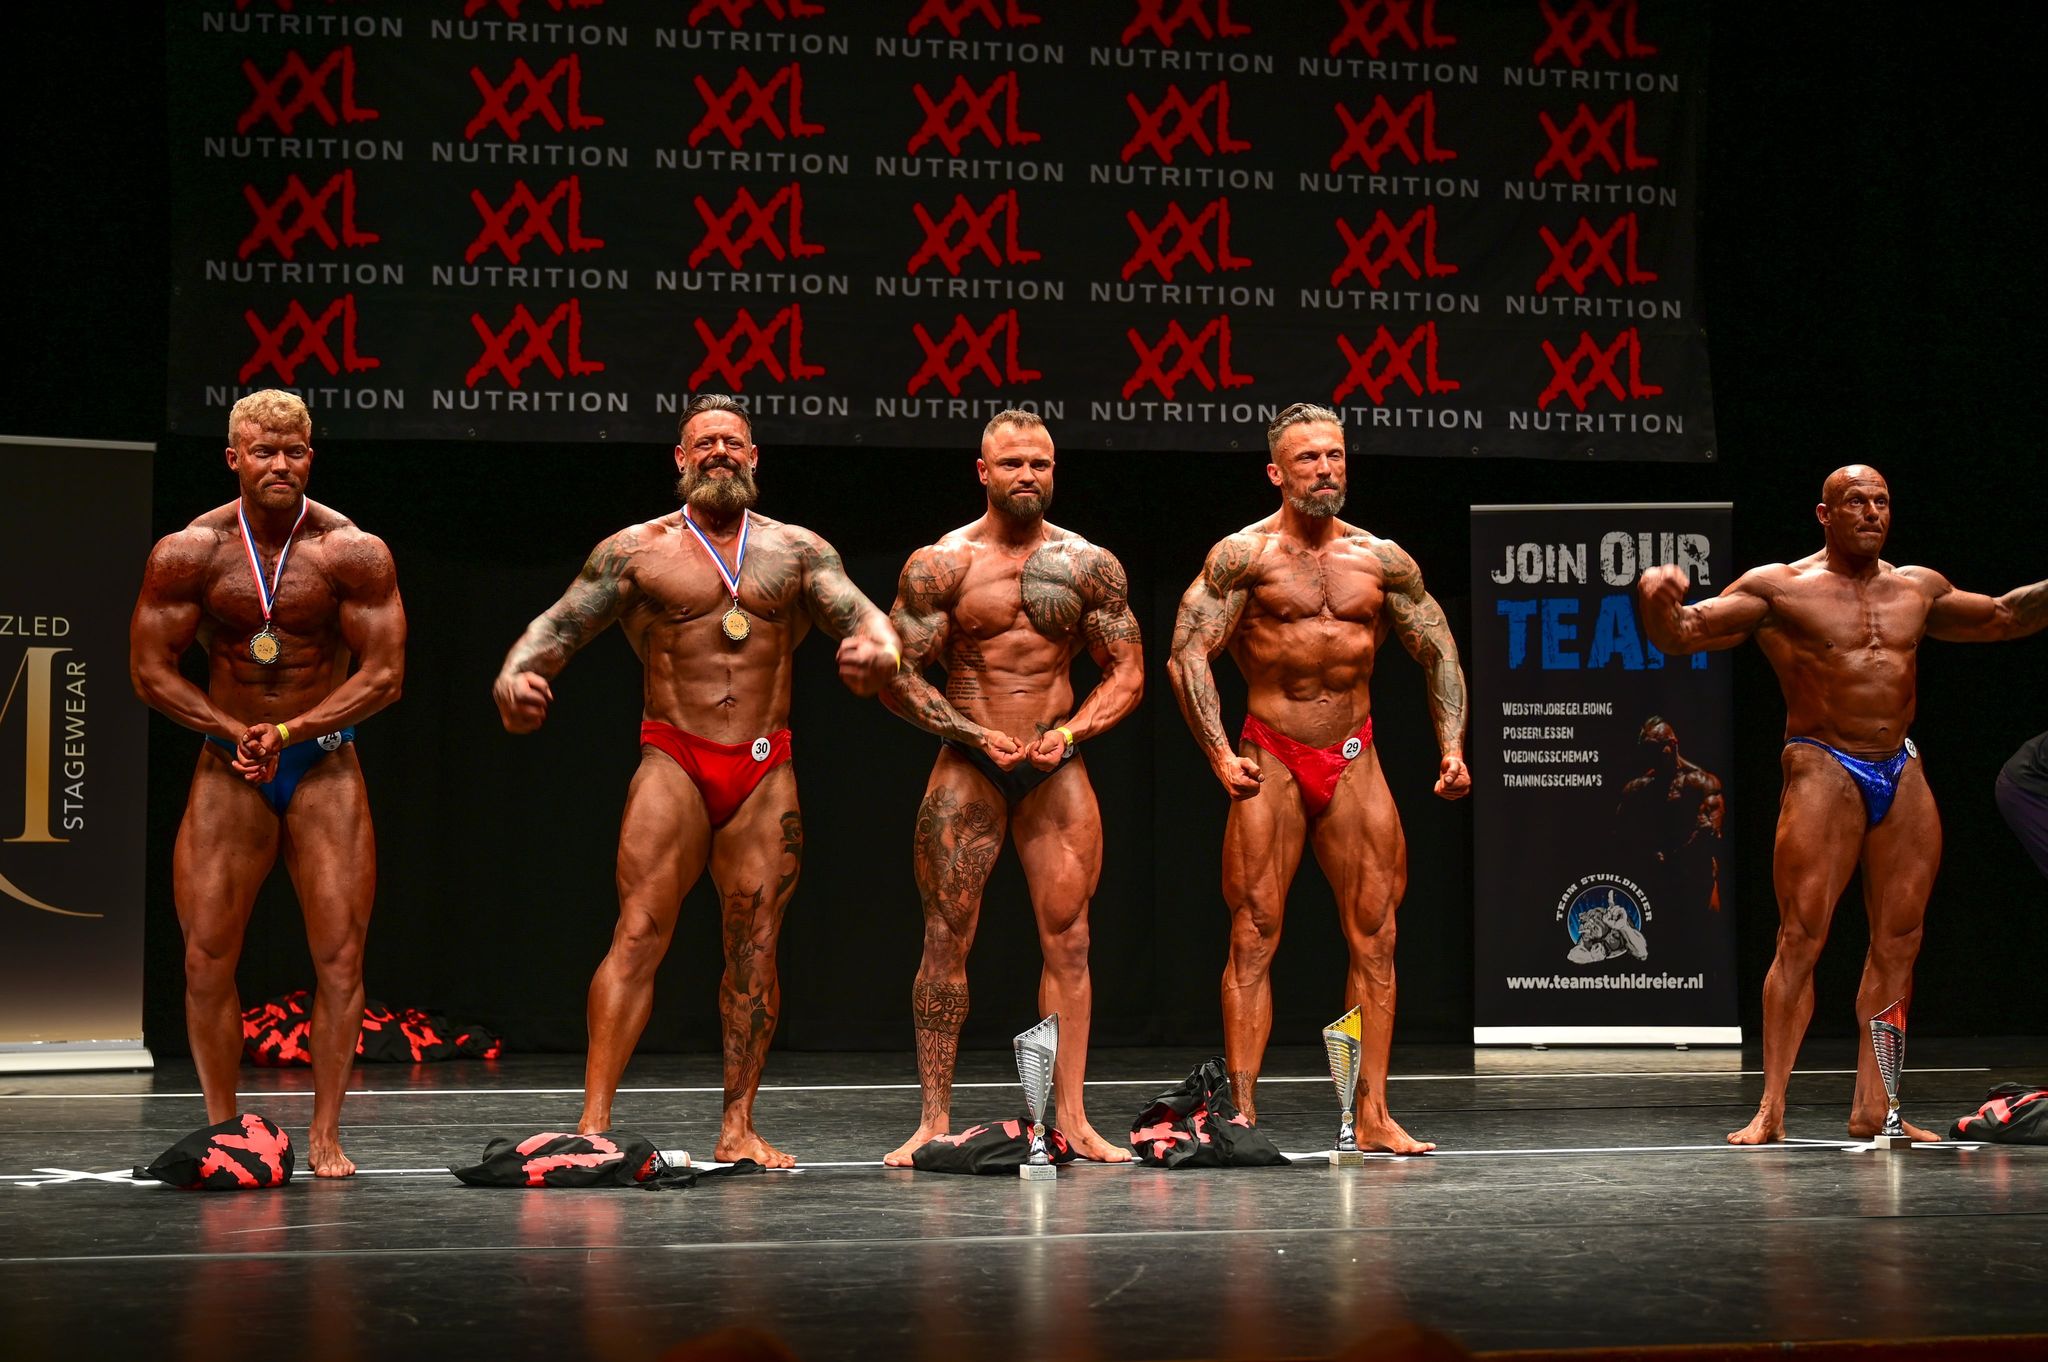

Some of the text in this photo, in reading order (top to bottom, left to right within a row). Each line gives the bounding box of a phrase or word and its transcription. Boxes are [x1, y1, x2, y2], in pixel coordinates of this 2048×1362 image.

[202, 11, 402, 38] NUTRITION
[431, 19, 627, 46] NUTRITION
[1533, 0, 1657, 68] XXL
[656, 28, 848, 55] NUTRITION
[876, 37, 1063, 64] NUTRITION
[1090, 47, 1273, 74] NUTRITION
[1300, 57, 1477, 84] NUTRITION
[238, 45, 380, 134] XXL
[1504, 67, 1679, 93] NUTRITION
[464, 52, 606, 142] XXL
[687, 61, 826, 150] XXL
[906, 70, 1041, 158] XXL
[1120, 79, 1253, 165] XXL
[1329, 89, 1458, 174] XXL
[1534, 98, 1659, 182] XXL
[204, 137, 403, 162] NUTRITION
[432, 142, 628, 167] NUTRITION
[656, 148, 849, 174] NUTRITION
[876, 156, 1063, 182] NUTRITION
[1090, 164, 1273, 190] NUTRITION
[1300, 172, 1479, 198] NUTRITION
[1504, 181, 1677, 206] NUTRITION
[238, 167, 381, 261] XXL
[464, 174, 606, 266] XXL
[687, 181, 827, 272] XXL
[906, 187, 1042, 277] XXL
[1120, 195, 1254, 284] XXL
[1329, 203, 1460, 290] XXL
[1535, 211, 1659, 296] XXL
[206, 260, 404, 285] NUTRITION
[432, 265, 628, 290] NUTRITION
[656, 270, 848, 295] NUTRITION
[876, 276, 1064, 301] NUTRITION
[1091, 282, 1275, 307] NUTRITION
[1301, 289, 1480, 313] NUTRITION
[1506, 295, 1681, 319] NUTRITION
[238, 292, 381, 386] XXL
[464, 297, 606, 390] XXL
[687, 302, 827, 394] XXL
[906, 307, 1044, 399] XXL
[1121, 313, 1256, 401] XXL
[1331, 319, 1462, 407] XXL
[1536, 325, 1665, 413] XXL
[206, 386, 405, 410] NITION
[432, 389, 628, 413] NUTRITION
[875, 397, 1064, 420] NUTRITON
[1091, 401, 1278, 424] NUTRITION
[1328, 406, 1483, 430] TRITION
[1509, 410, 1684, 434] NUTRITION
[1490, 531, 1711, 586] JOIN OUR
[63, 661, 87, 830] STAGEWEAR
[322, 731, 338, 744] 24
[755, 742, 768, 755] 30
[1345, 741, 1359, 753] 29
[1556, 873, 1653, 922] TEAM STUHLDREIER
[1506, 972, 1704, 990] www.teamstuhldreier.nl
